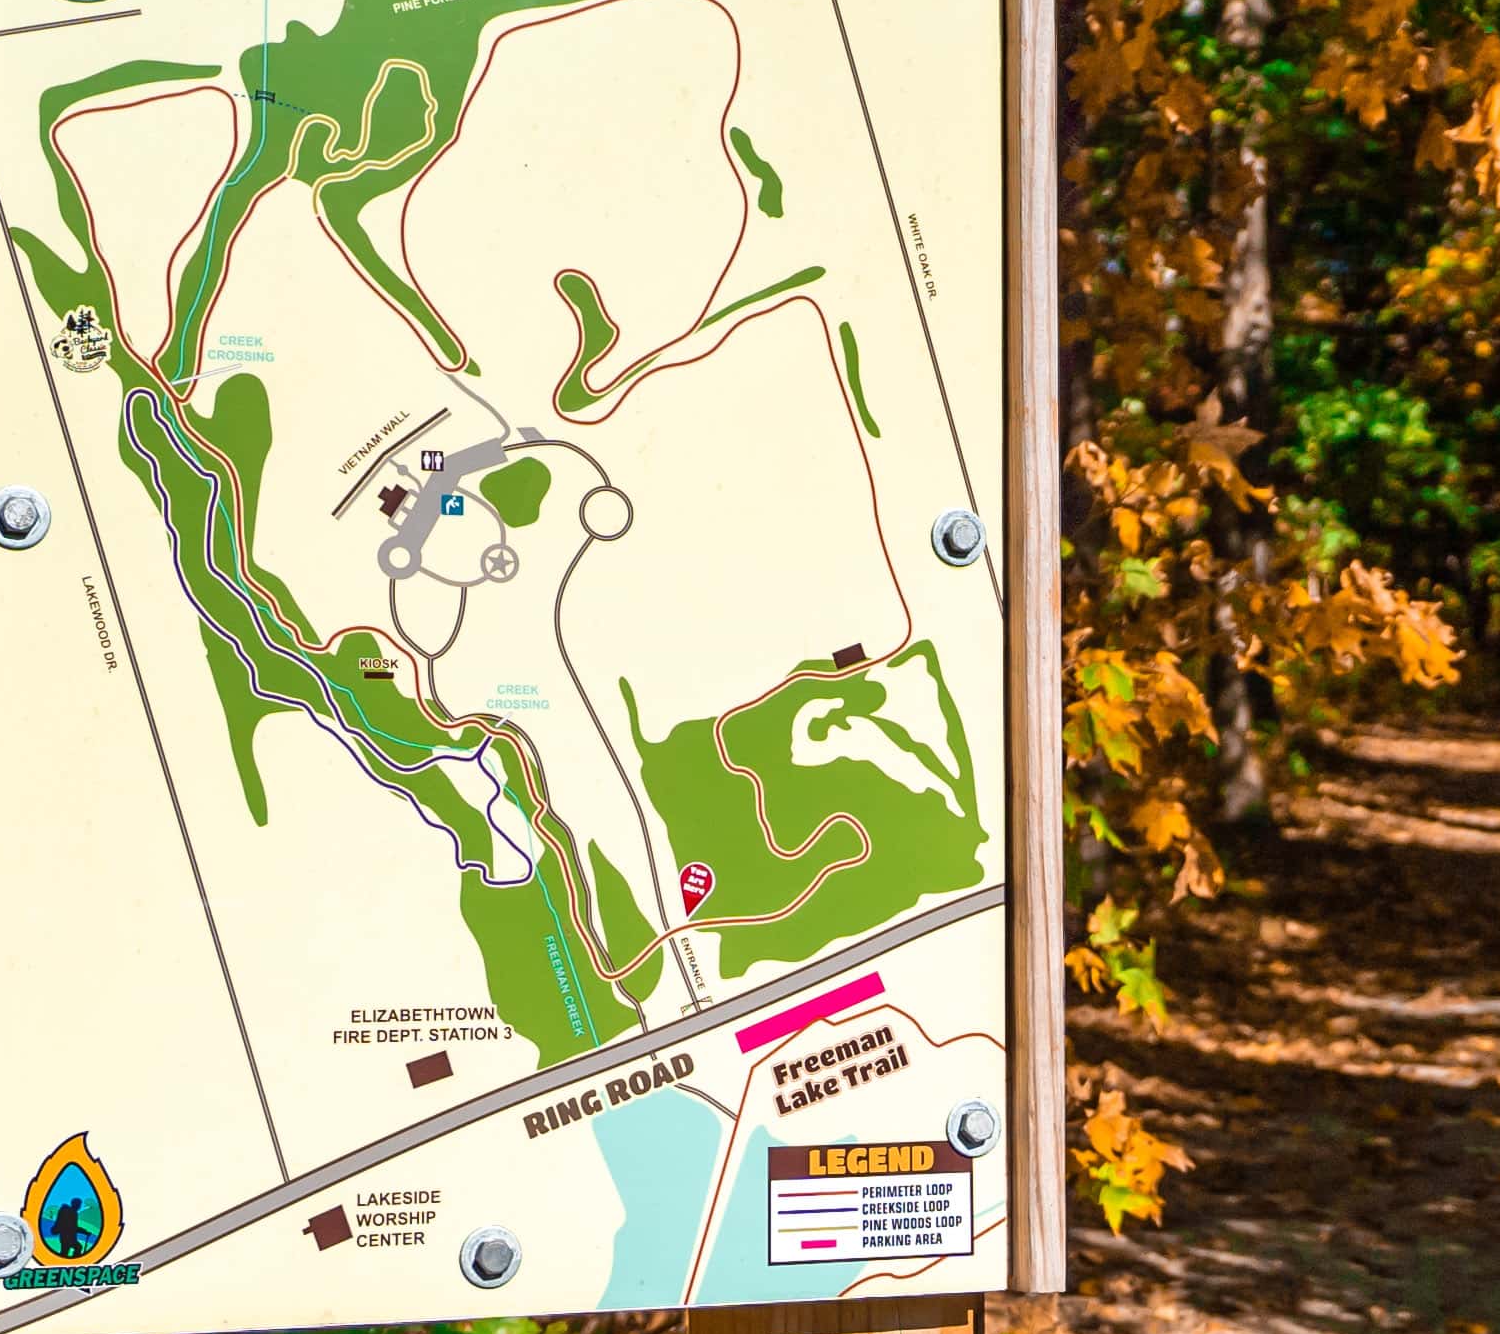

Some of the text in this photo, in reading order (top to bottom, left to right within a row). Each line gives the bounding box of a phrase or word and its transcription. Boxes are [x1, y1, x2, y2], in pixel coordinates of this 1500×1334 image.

[908, 213, 924, 251] WHITE
[918, 253, 932, 279] OAK
[219, 335, 263, 347] CREEK
[207, 350, 274, 362] CROSSING
[338, 410, 410, 475] VIETNAM WALL
[82, 575, 117, 673] LAKEWOOD DR.
[360, 658, 399, 669] KIOSK
[497, 684, 539, 695] CREEK
[486, 698, 550, 709] CROSSING
[680, 937, 706, 989] ENTRANCE
[545, 935, 585, 1037] FREEMAN CREEK
[350, 1007, 495, 1023] ELIZABETHTOWN
[333, 1027, 512, 1044] FIRE DEPT. STATION 3
[772, 1025, 895, 1087] Freeman
[775, 1045, 910, 1116] Lake Trail
[522, 1052, 696, 1140] RING ROAD
[808, 1145, 935, 1176] LEGEND
[357, 1190, 441, 1206] LAKESIDE
[862, 1184, 953, 1198] PERIMETER LOOP
[862, 1200, 950, 1215] CREEKSIDE LOOP
[356, 1211, 436, 1227] WORSHIP
[862, 1216, 962, 1232] PINE WOODS LOOP
[356, 1232, 425, 1248] CENTER
[862, 1233, 943, 1248] PARKING AREA
